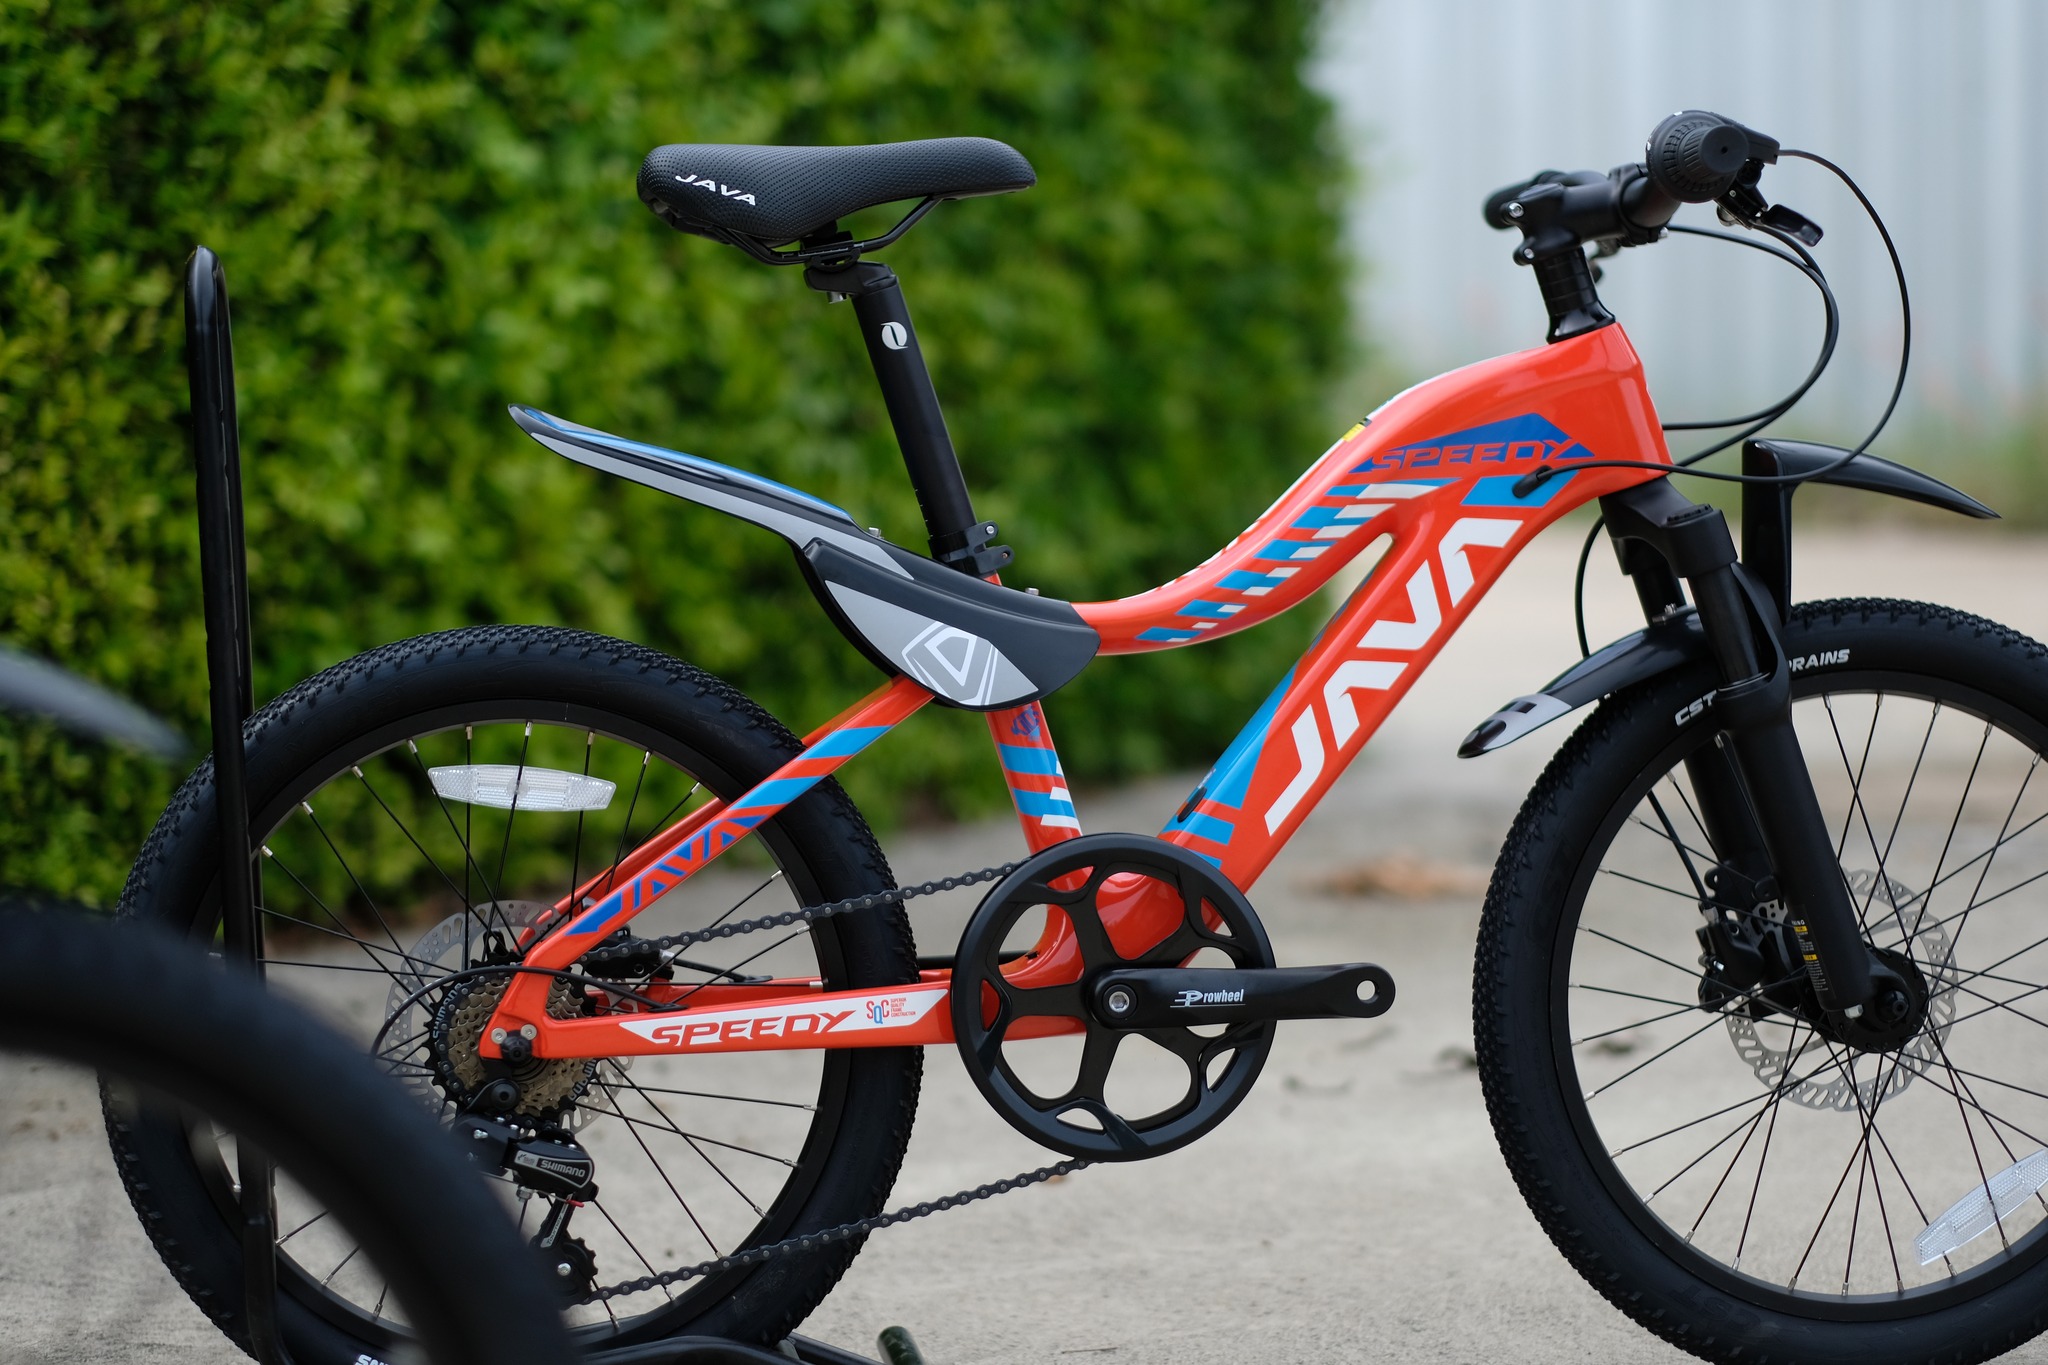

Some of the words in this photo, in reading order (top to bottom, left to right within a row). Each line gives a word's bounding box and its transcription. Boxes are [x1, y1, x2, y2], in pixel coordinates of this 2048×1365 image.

[675, 174, 756, 206] JAVA
[1371, 439, 1573, 471] SPEEDY
[1264, 517, 1523, 837] JAVA
[1674, 690, 1717, 726] CST
[598, 819, 751, 930] JAVA
[866, 999, 890, 1024] SQC
[1173, 988, 1245, 1007] Prowheel
[651, 1010, 856, 1047] SPEEDY
[540, 1160, 586, 1178] SHIMANO
